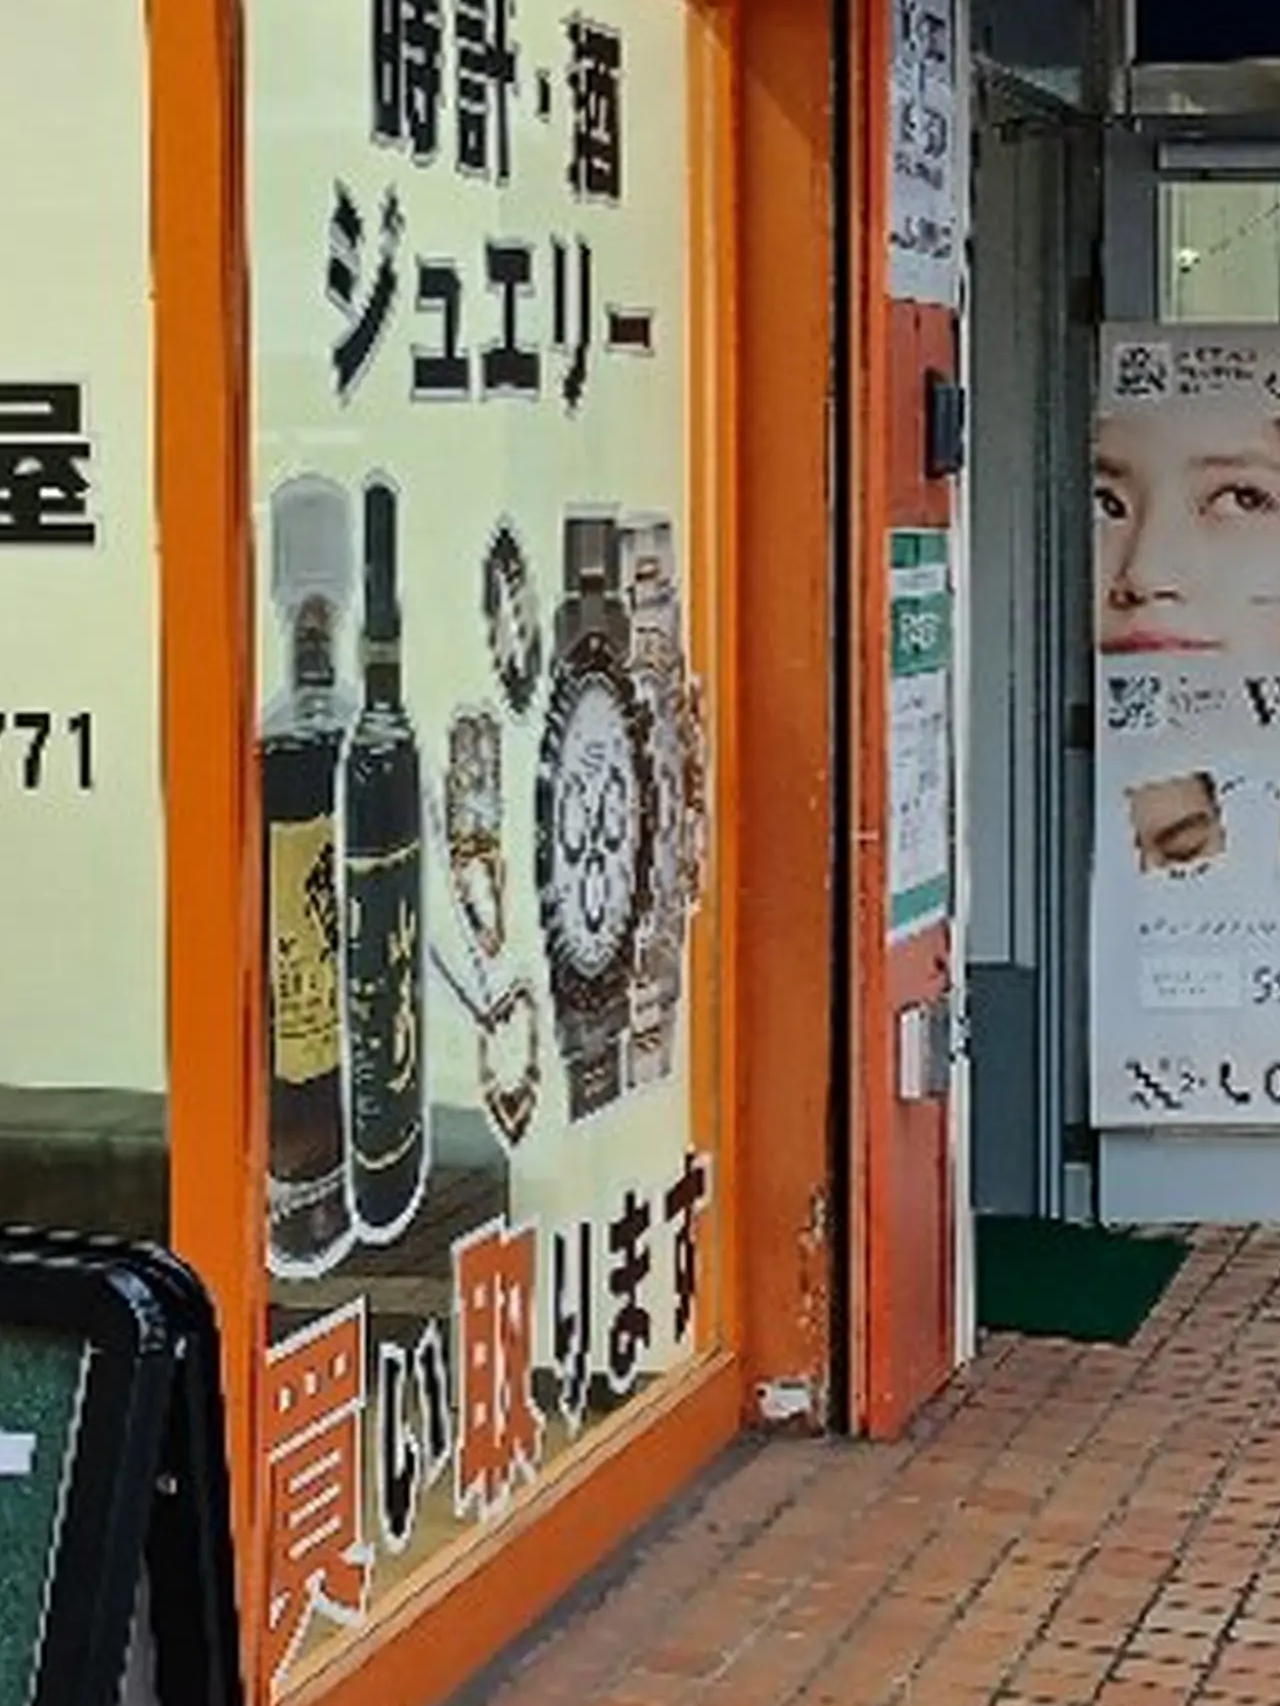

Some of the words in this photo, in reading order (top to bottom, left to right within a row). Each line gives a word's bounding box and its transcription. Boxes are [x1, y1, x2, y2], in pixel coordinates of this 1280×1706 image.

[325, 177, 656, 417] ジュエリー
